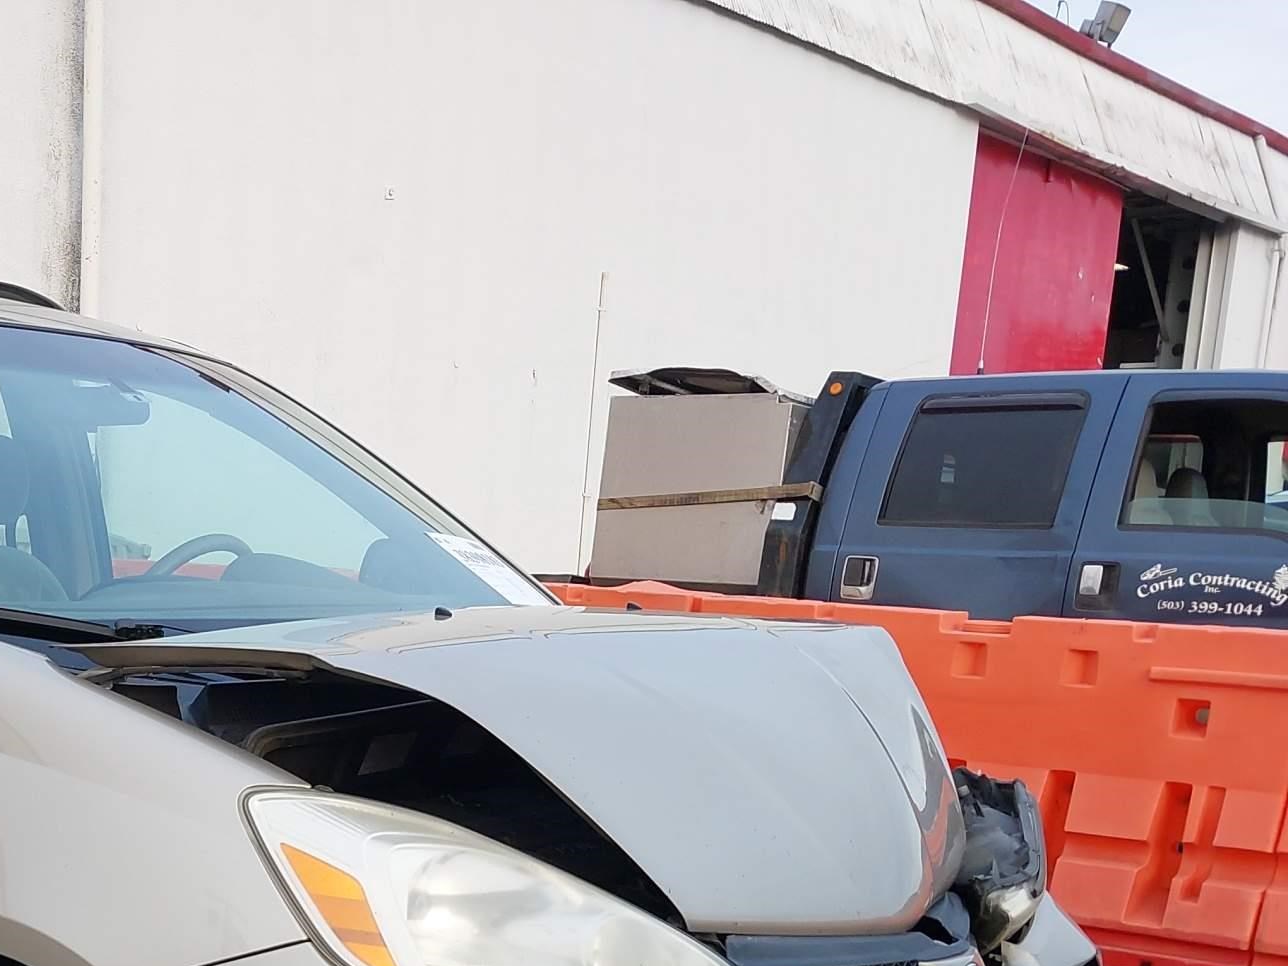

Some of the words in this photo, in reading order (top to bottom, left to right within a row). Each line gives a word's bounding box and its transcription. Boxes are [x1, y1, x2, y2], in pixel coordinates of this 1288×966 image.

[1136, 575, 1185, 598] Coria
[1189, 572, 1288, 606] Contracting
[1157, 600, 1185, 611] (503)
[1188, 601, 1263, 616] 399-1044
